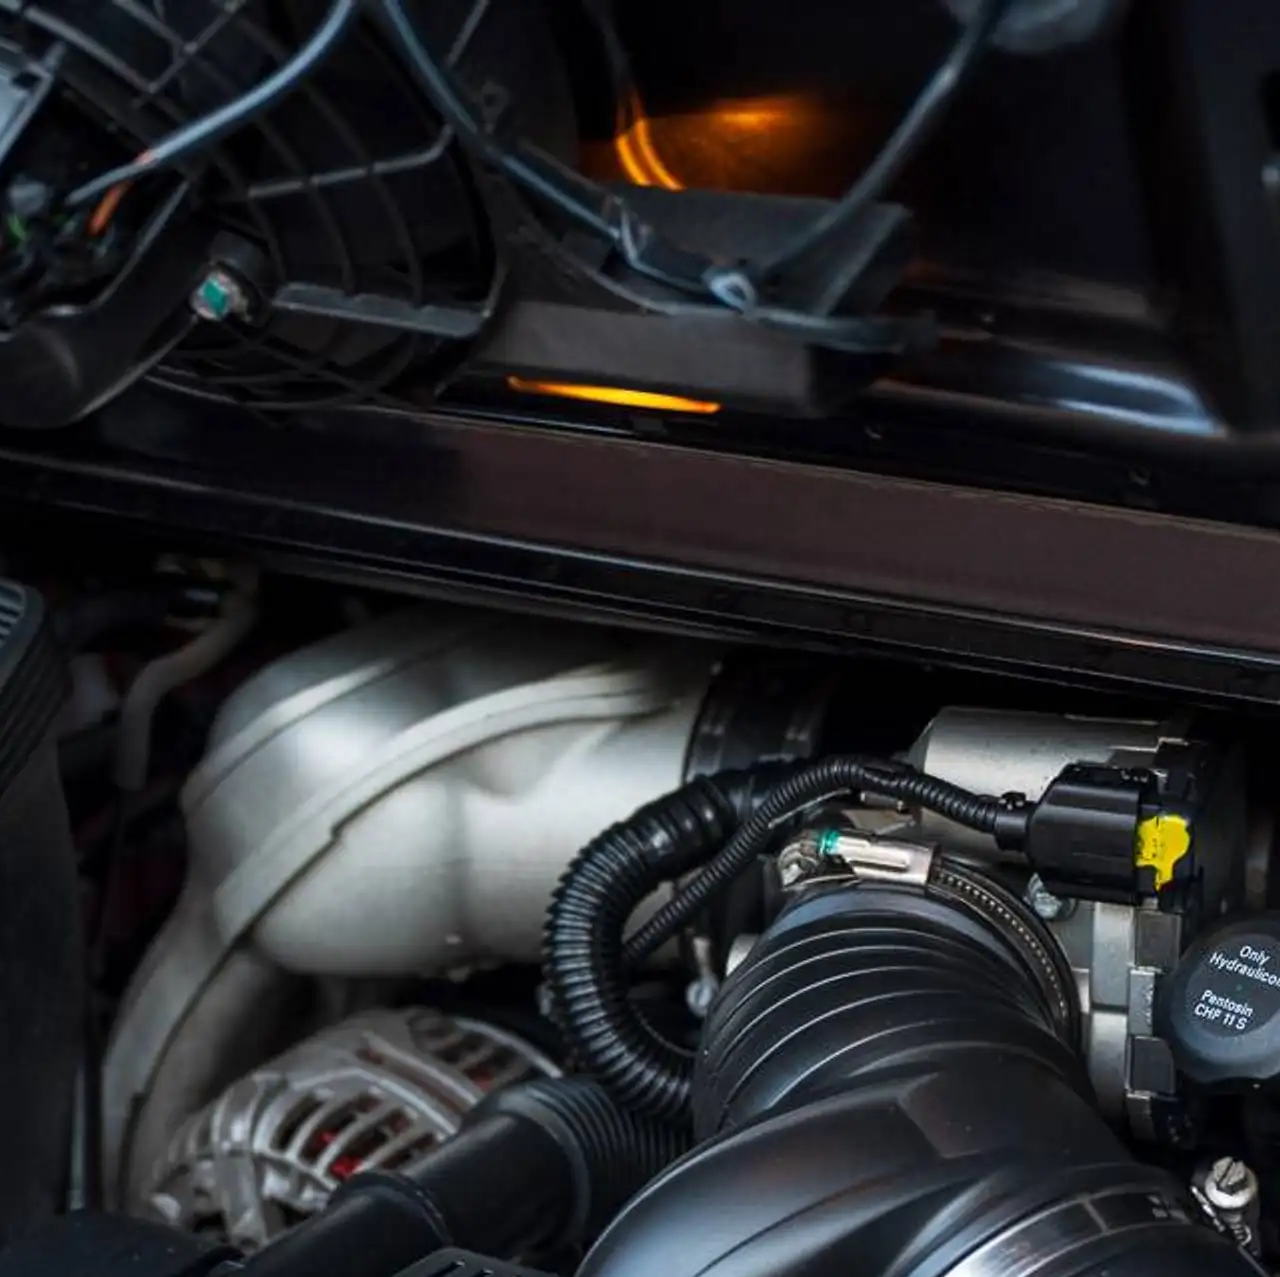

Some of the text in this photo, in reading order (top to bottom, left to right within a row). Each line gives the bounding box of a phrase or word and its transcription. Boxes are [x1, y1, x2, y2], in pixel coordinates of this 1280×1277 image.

[1239, 945, 1271, 965] Only
[1194, 1003, 1222, 1020] CHF
[1236, 1018, 1248, 1030] S
[1201, 989, 1254, 1017] Pentosin
